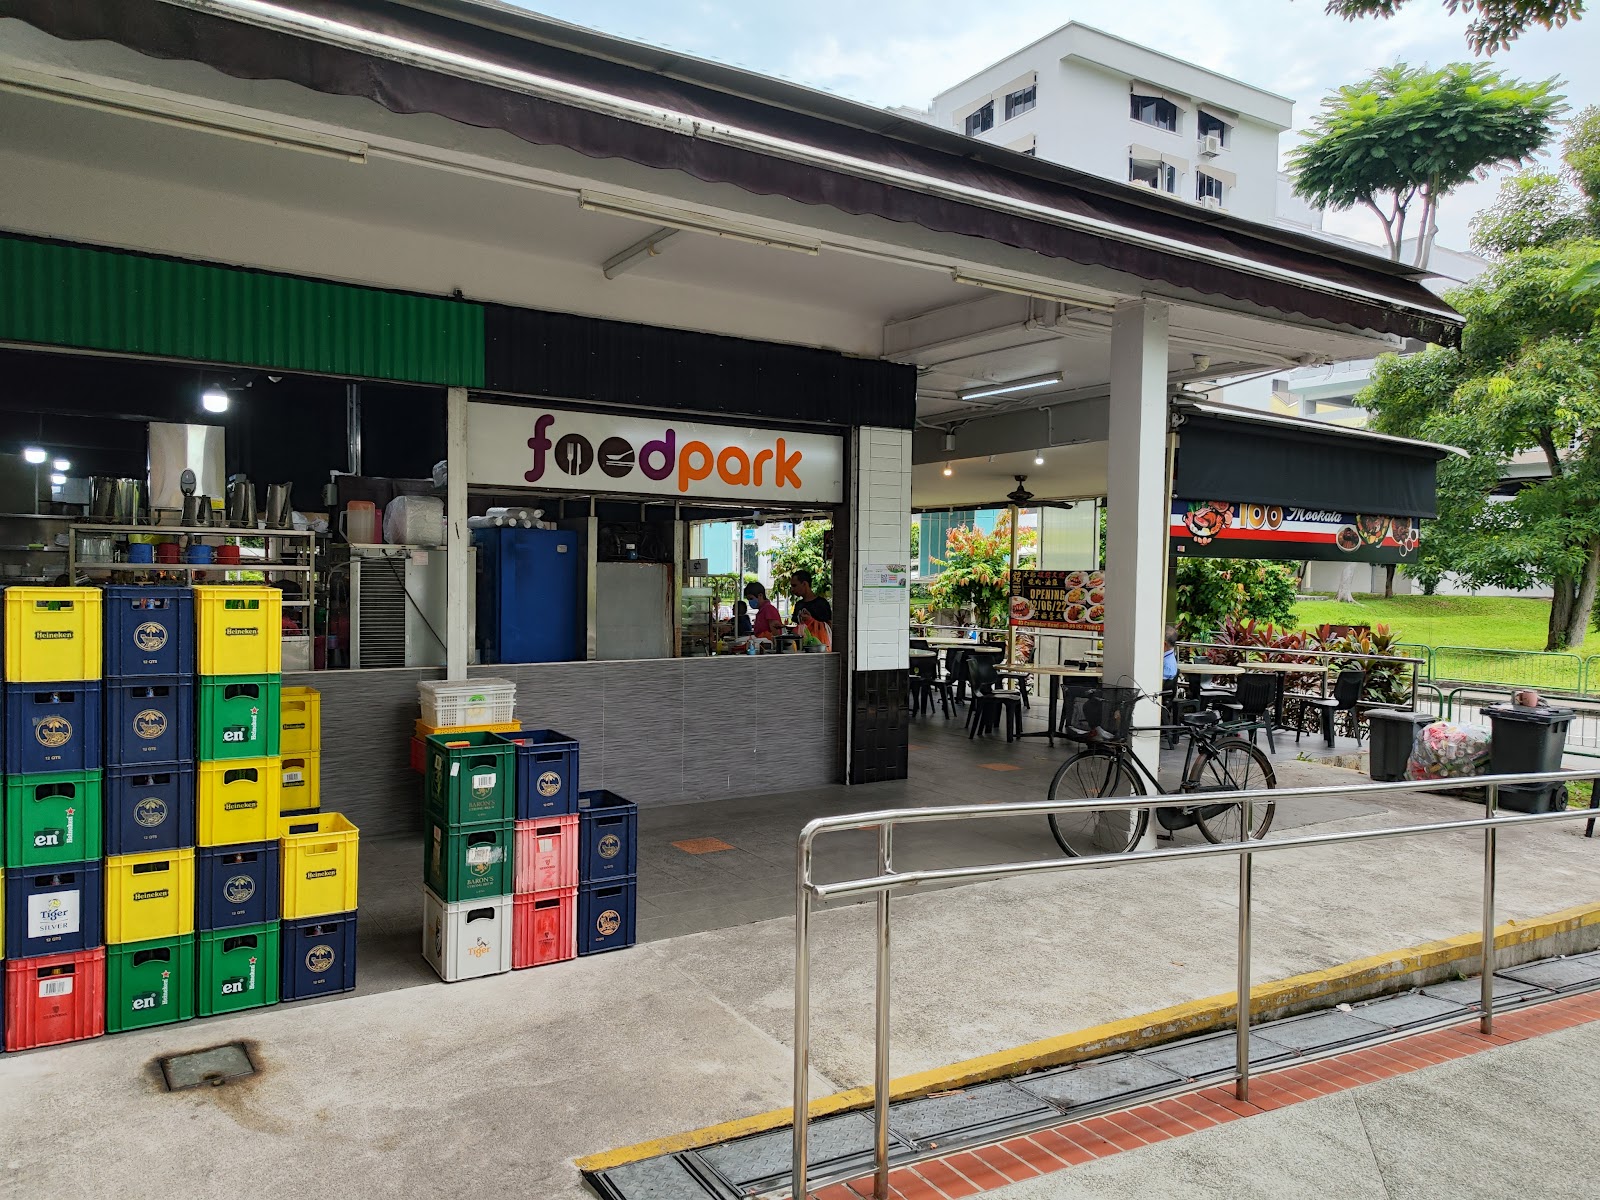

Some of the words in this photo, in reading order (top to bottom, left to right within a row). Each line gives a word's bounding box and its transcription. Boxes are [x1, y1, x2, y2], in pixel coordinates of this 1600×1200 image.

[524, 414, 803, 493] foodpark
[1030, 589, 1065, 600] OPENING
[1029, 600, 1067, 612] 12/06/22
[35, 630, 73, 640] Heineken
[225, 627, 258, 637] Heineken
[225, 801, 257, 811] Heineken
[468, 800, 496, 808] BARON'S
[307, 869, 337, 879] Heineken
[467, 876, 494, 885] BARON'S
[134, 889, 169, 900] Heineken
[40, 909, 68, 921] Tiger
[40, 923, 68, 932] SILVER
[467, 946, 490, 958] Tiger
